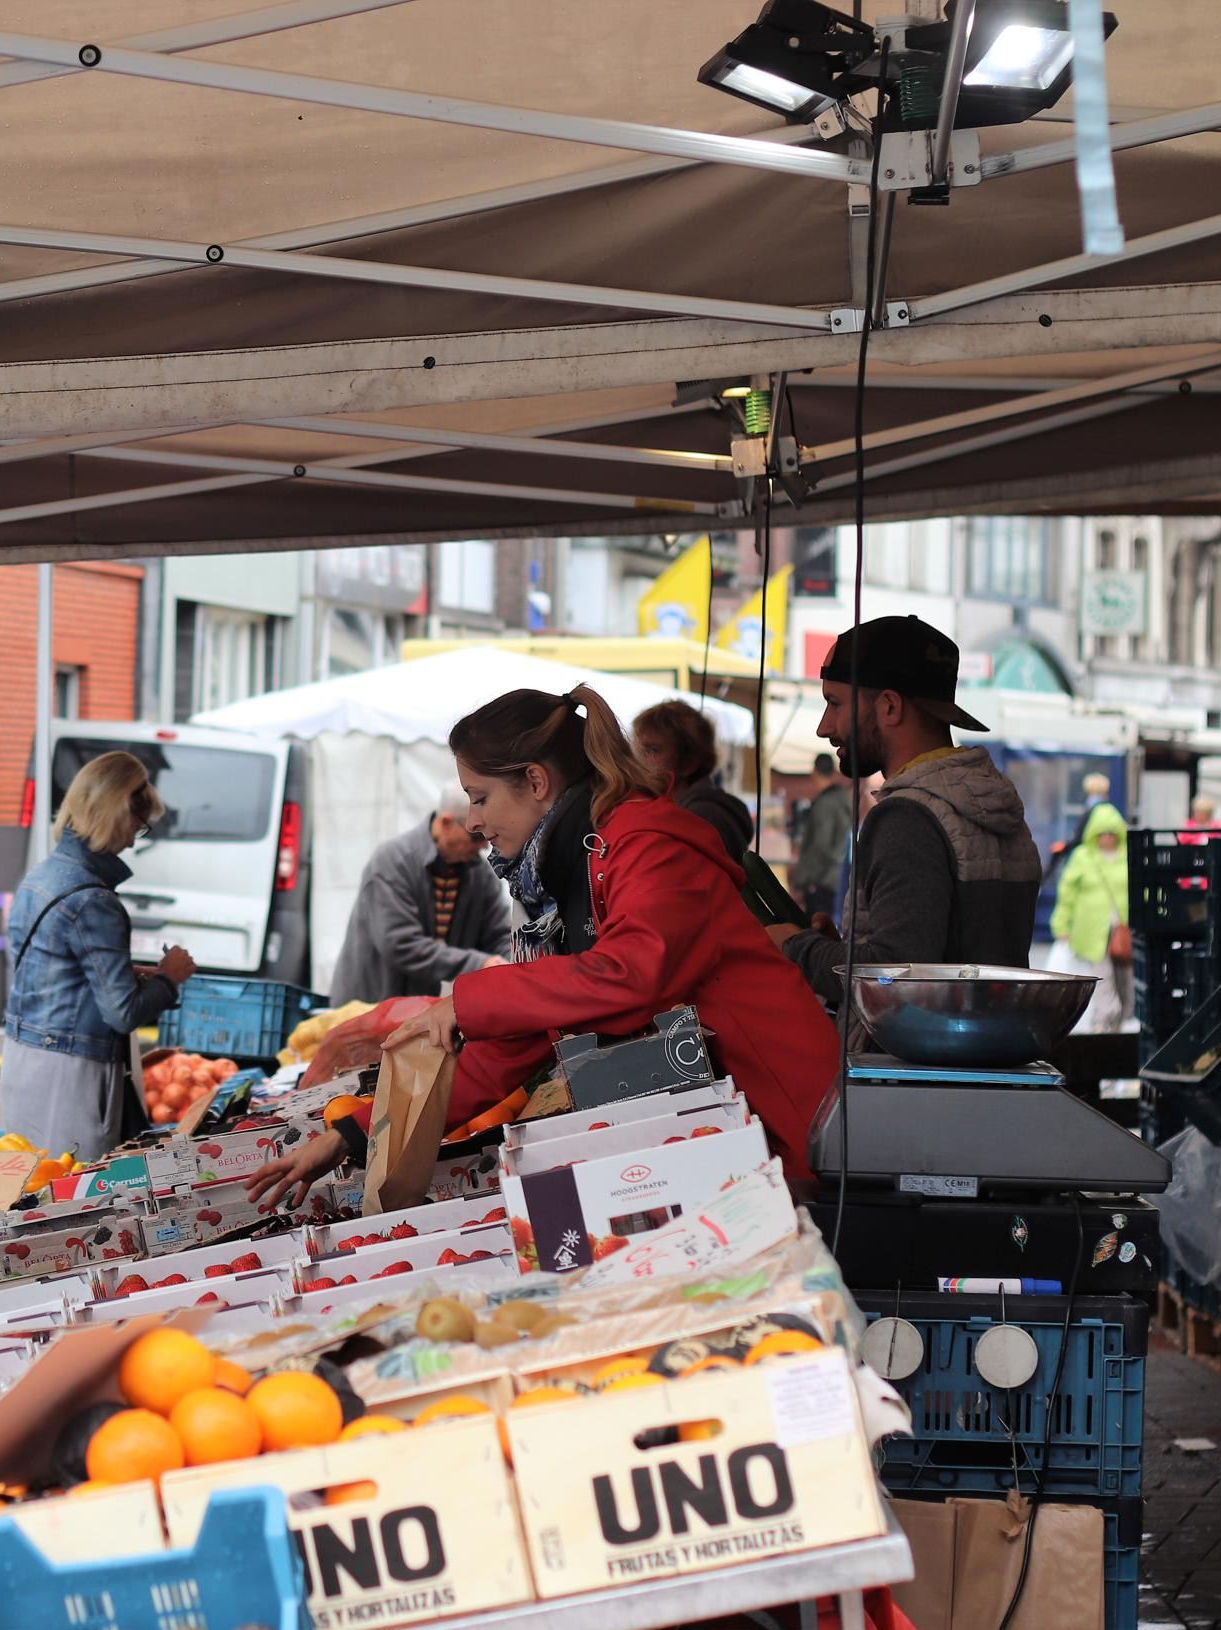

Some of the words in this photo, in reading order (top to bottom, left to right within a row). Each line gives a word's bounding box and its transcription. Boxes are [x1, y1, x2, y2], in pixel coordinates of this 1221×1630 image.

[610, 1179, 669, 1198] HOOGSTRATEN
[592, 1442, 794, 1545] UNO
[607, 1550, 677, 1578] FRUTAS
[681, 1546, 693, 1564] Y
[694, 1524, 804, 1561] HORTALIZAS
[333, 1608, 343, 1625] Y
[347, 1588, 456, 1621] HORTALIZAS
